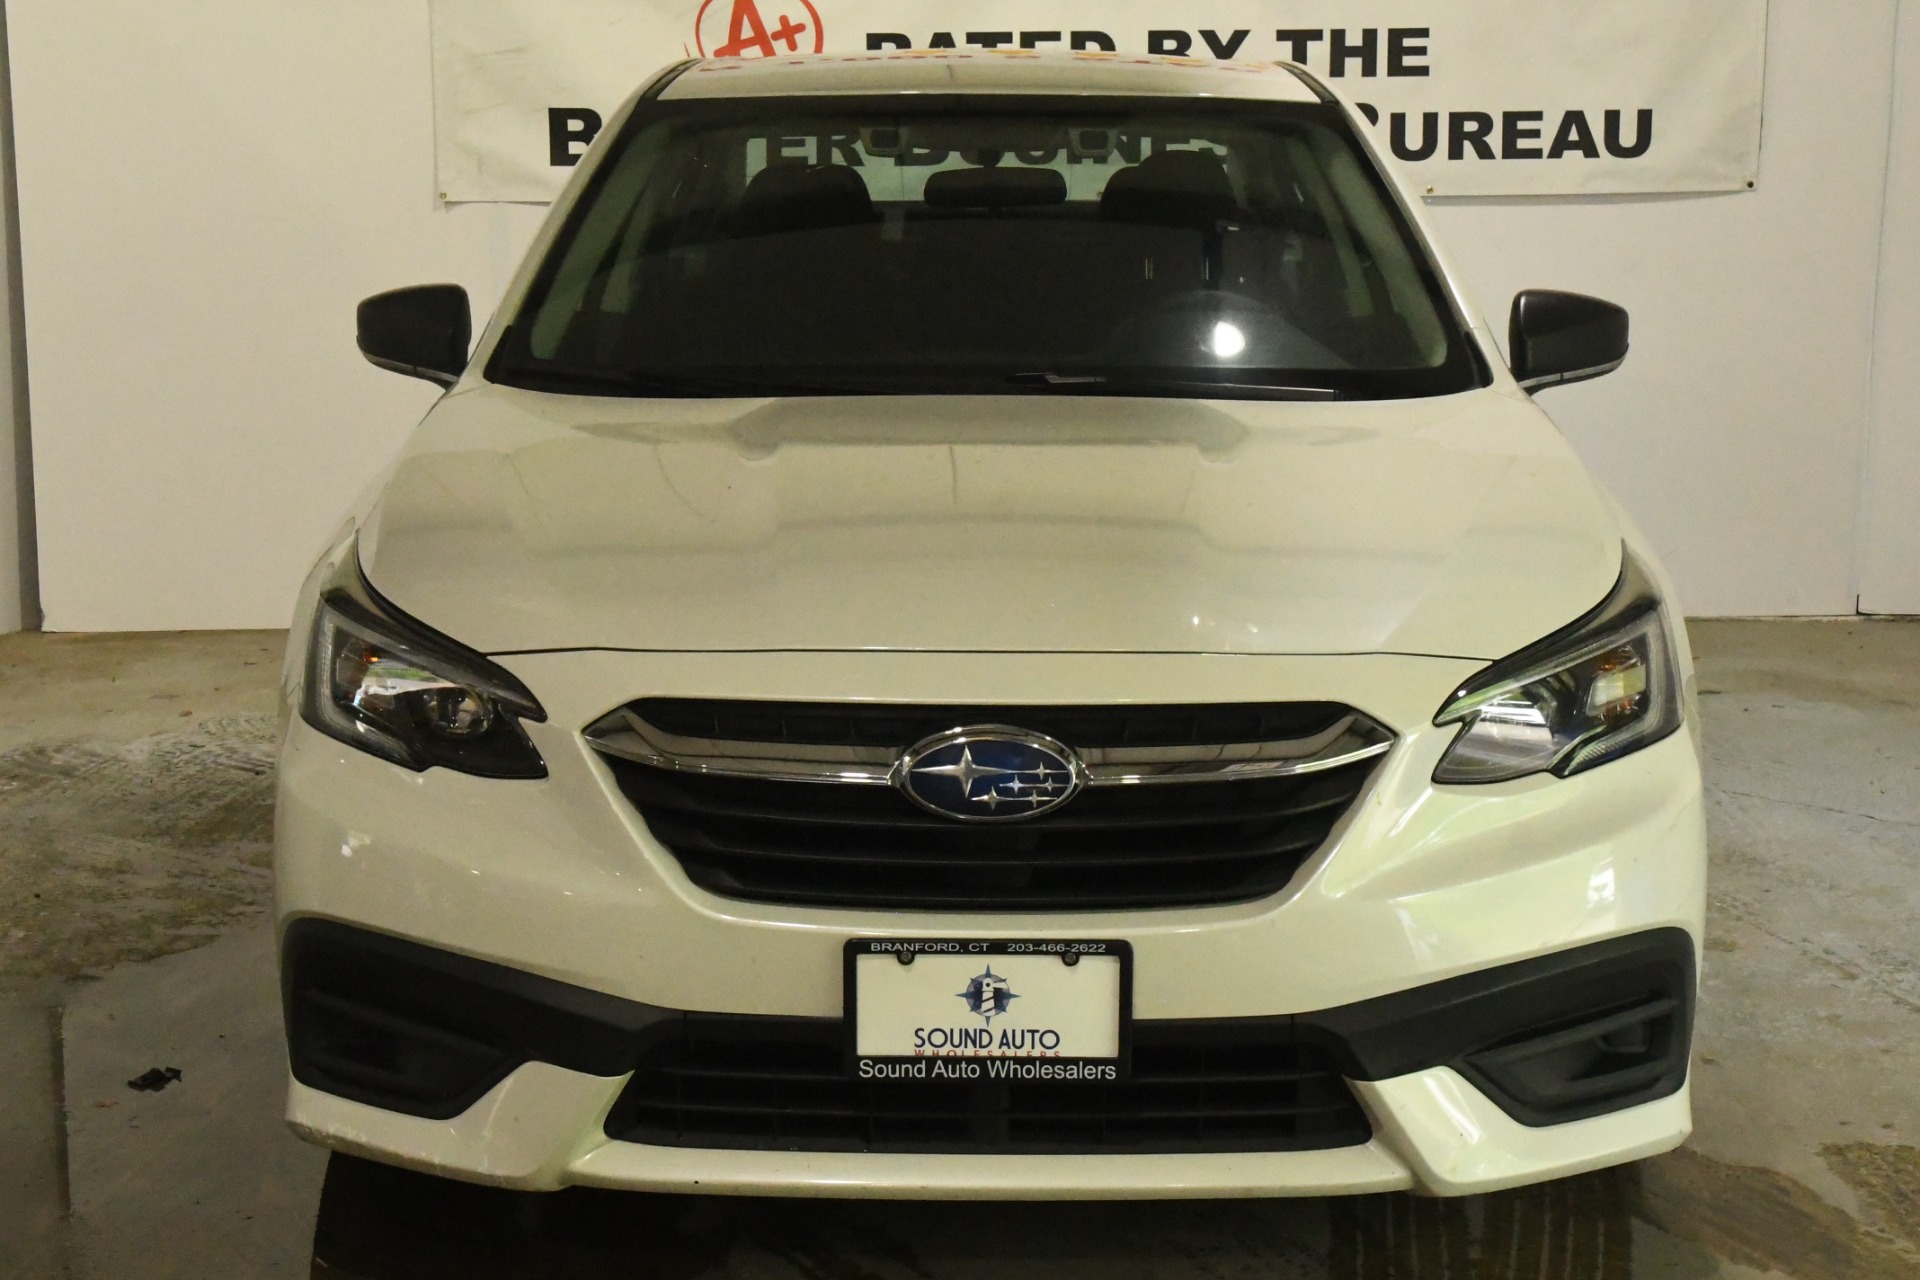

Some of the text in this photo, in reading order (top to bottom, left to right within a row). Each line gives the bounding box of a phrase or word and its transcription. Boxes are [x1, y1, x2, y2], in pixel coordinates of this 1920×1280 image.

[1276, 27, 1430, 78] THE
[1356, 102, 1653, 162] UREAU
[870, 942, 1107, 953] BRANFORD, CT 203-466-2622
[914, 1027, 1061, 1051] SOUND AUTO
[858, 1059, 1117, 1080] Sound Auto Wholesalers
